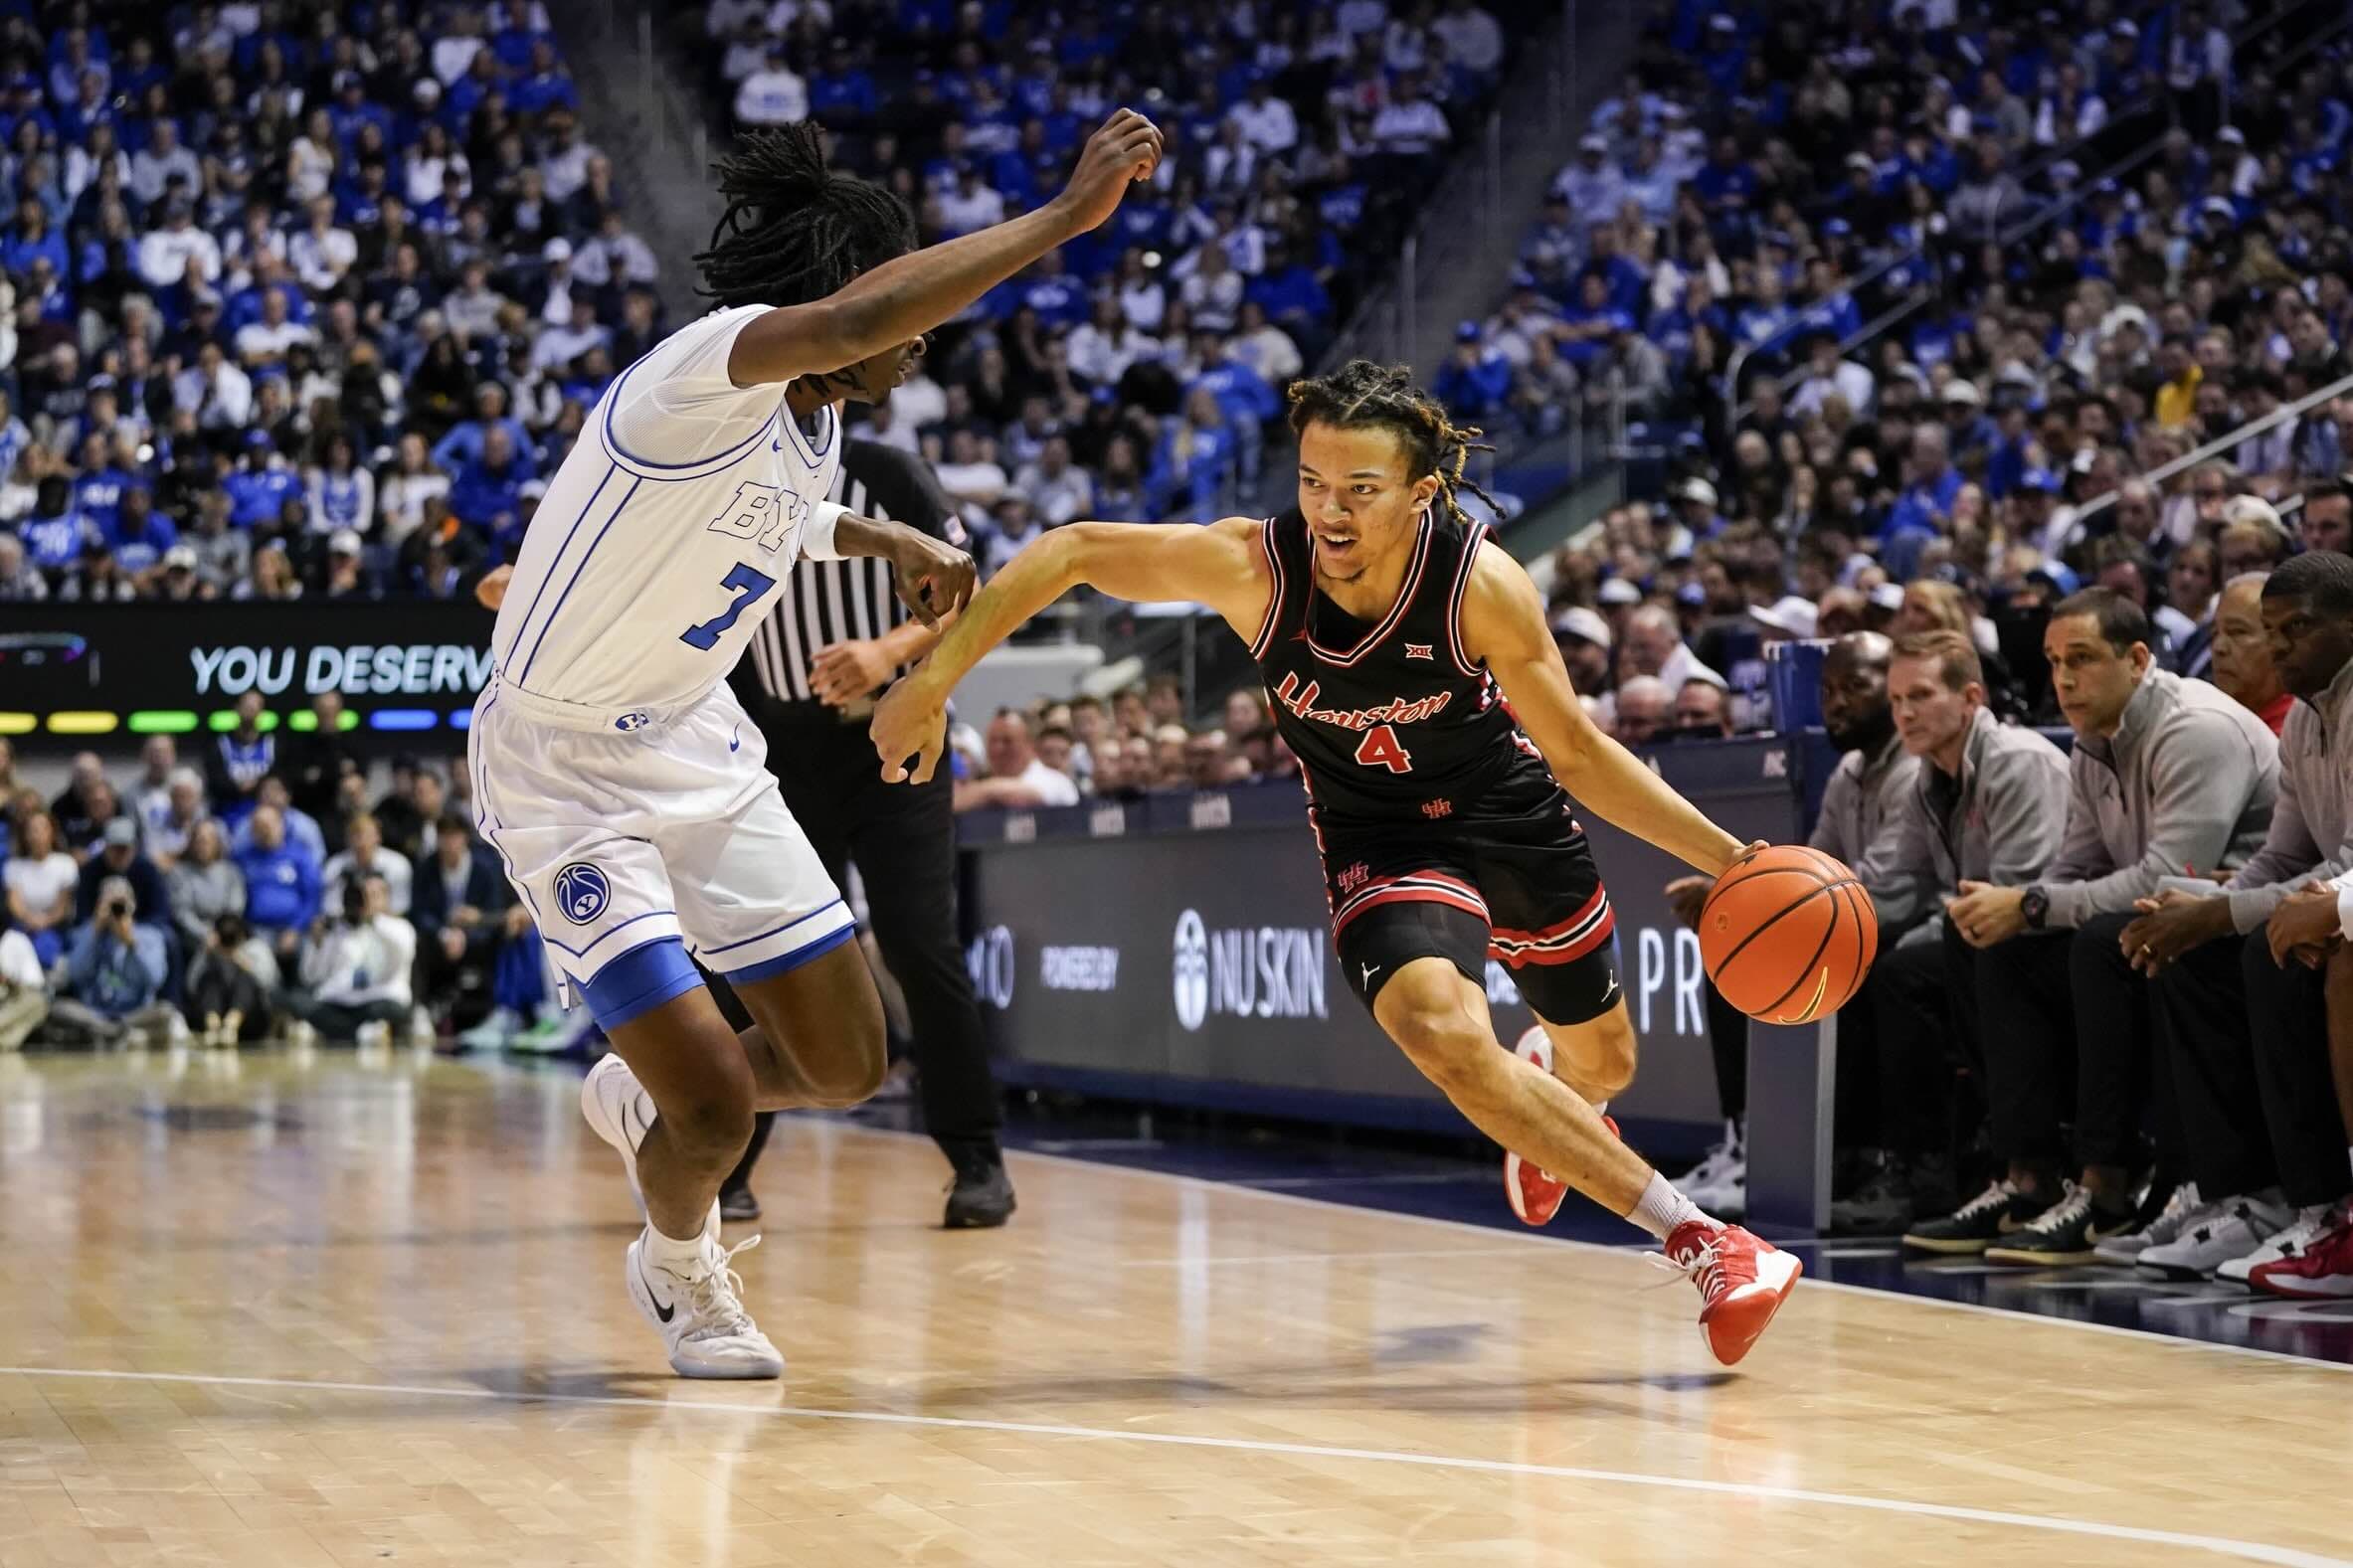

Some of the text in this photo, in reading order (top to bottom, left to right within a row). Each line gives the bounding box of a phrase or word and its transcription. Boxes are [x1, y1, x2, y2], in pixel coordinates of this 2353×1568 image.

[679, 561, 777, 651] 7
[191, 646, 295, 695] YOU
[1272, 670, 1452, 731] Houston
[1355, 724, 1413, 774] 4
